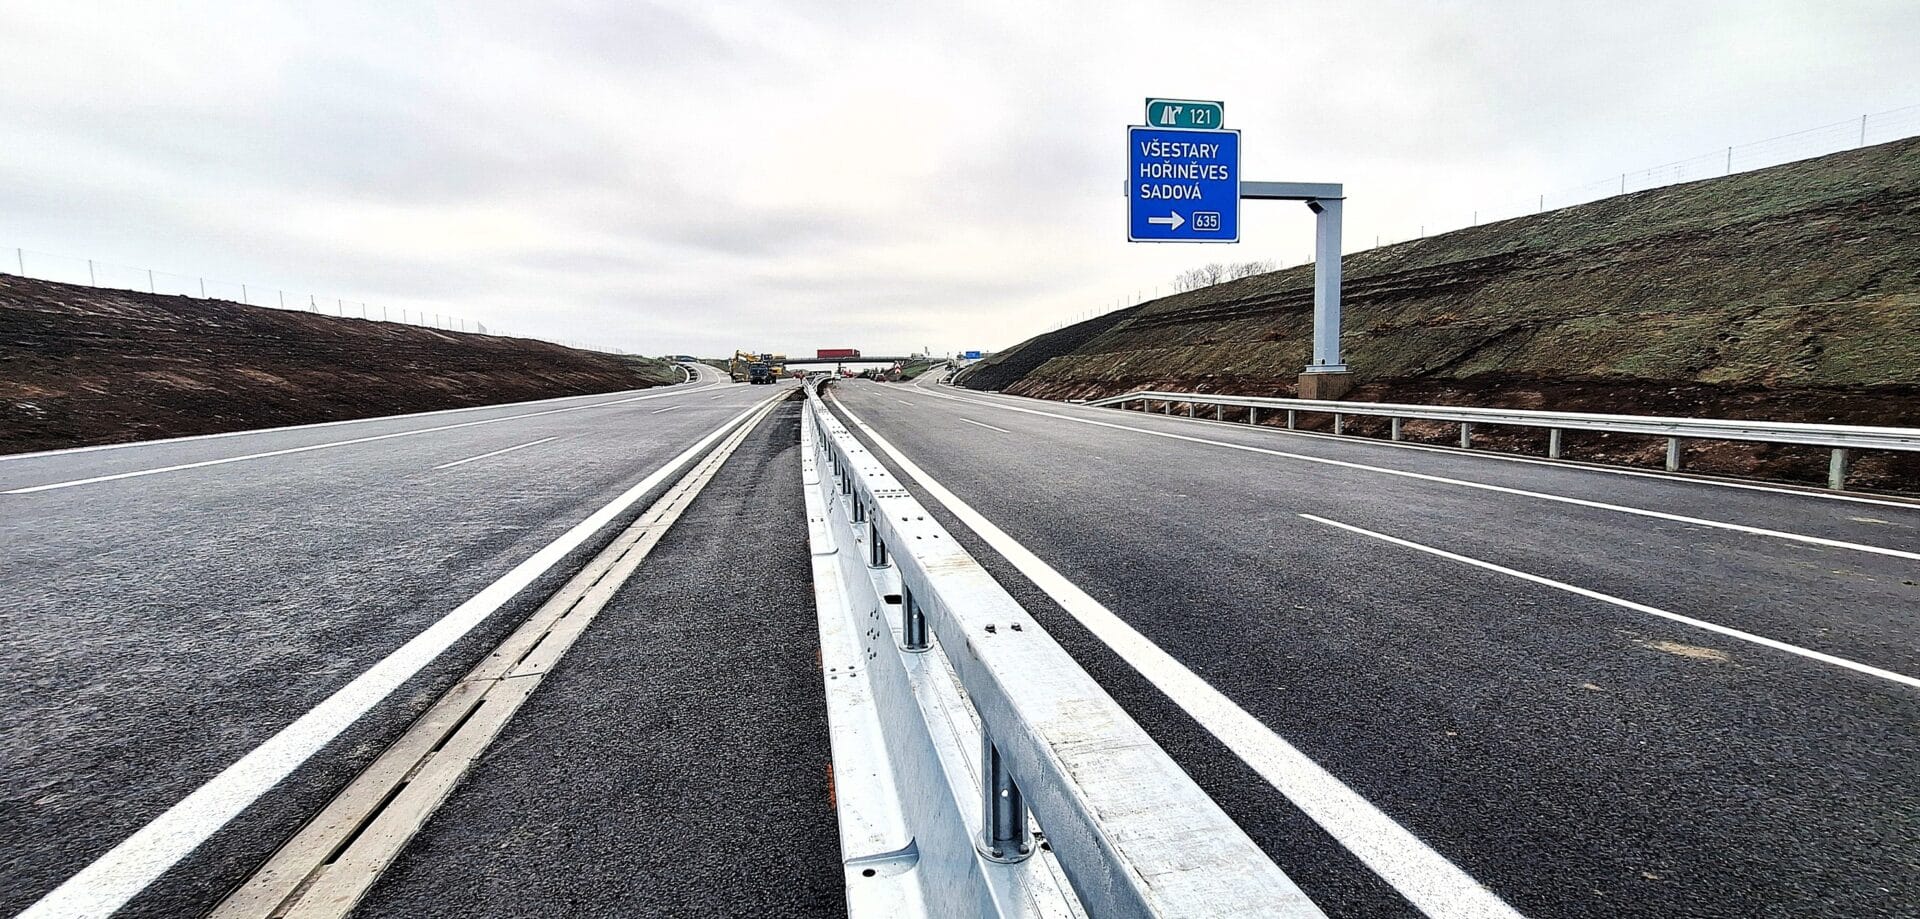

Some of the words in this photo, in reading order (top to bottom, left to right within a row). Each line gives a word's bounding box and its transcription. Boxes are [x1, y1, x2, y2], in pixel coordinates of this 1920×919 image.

[1190, 109, 1211, 124] 121
[1140, 138, 1220, 159] VŠESTARY
[1140, 160, 1229, 180] HOŘINĚVES
[1140, 182, 1202, 200] SADOVÁ
[1196, 215, 1217, 228] 635
